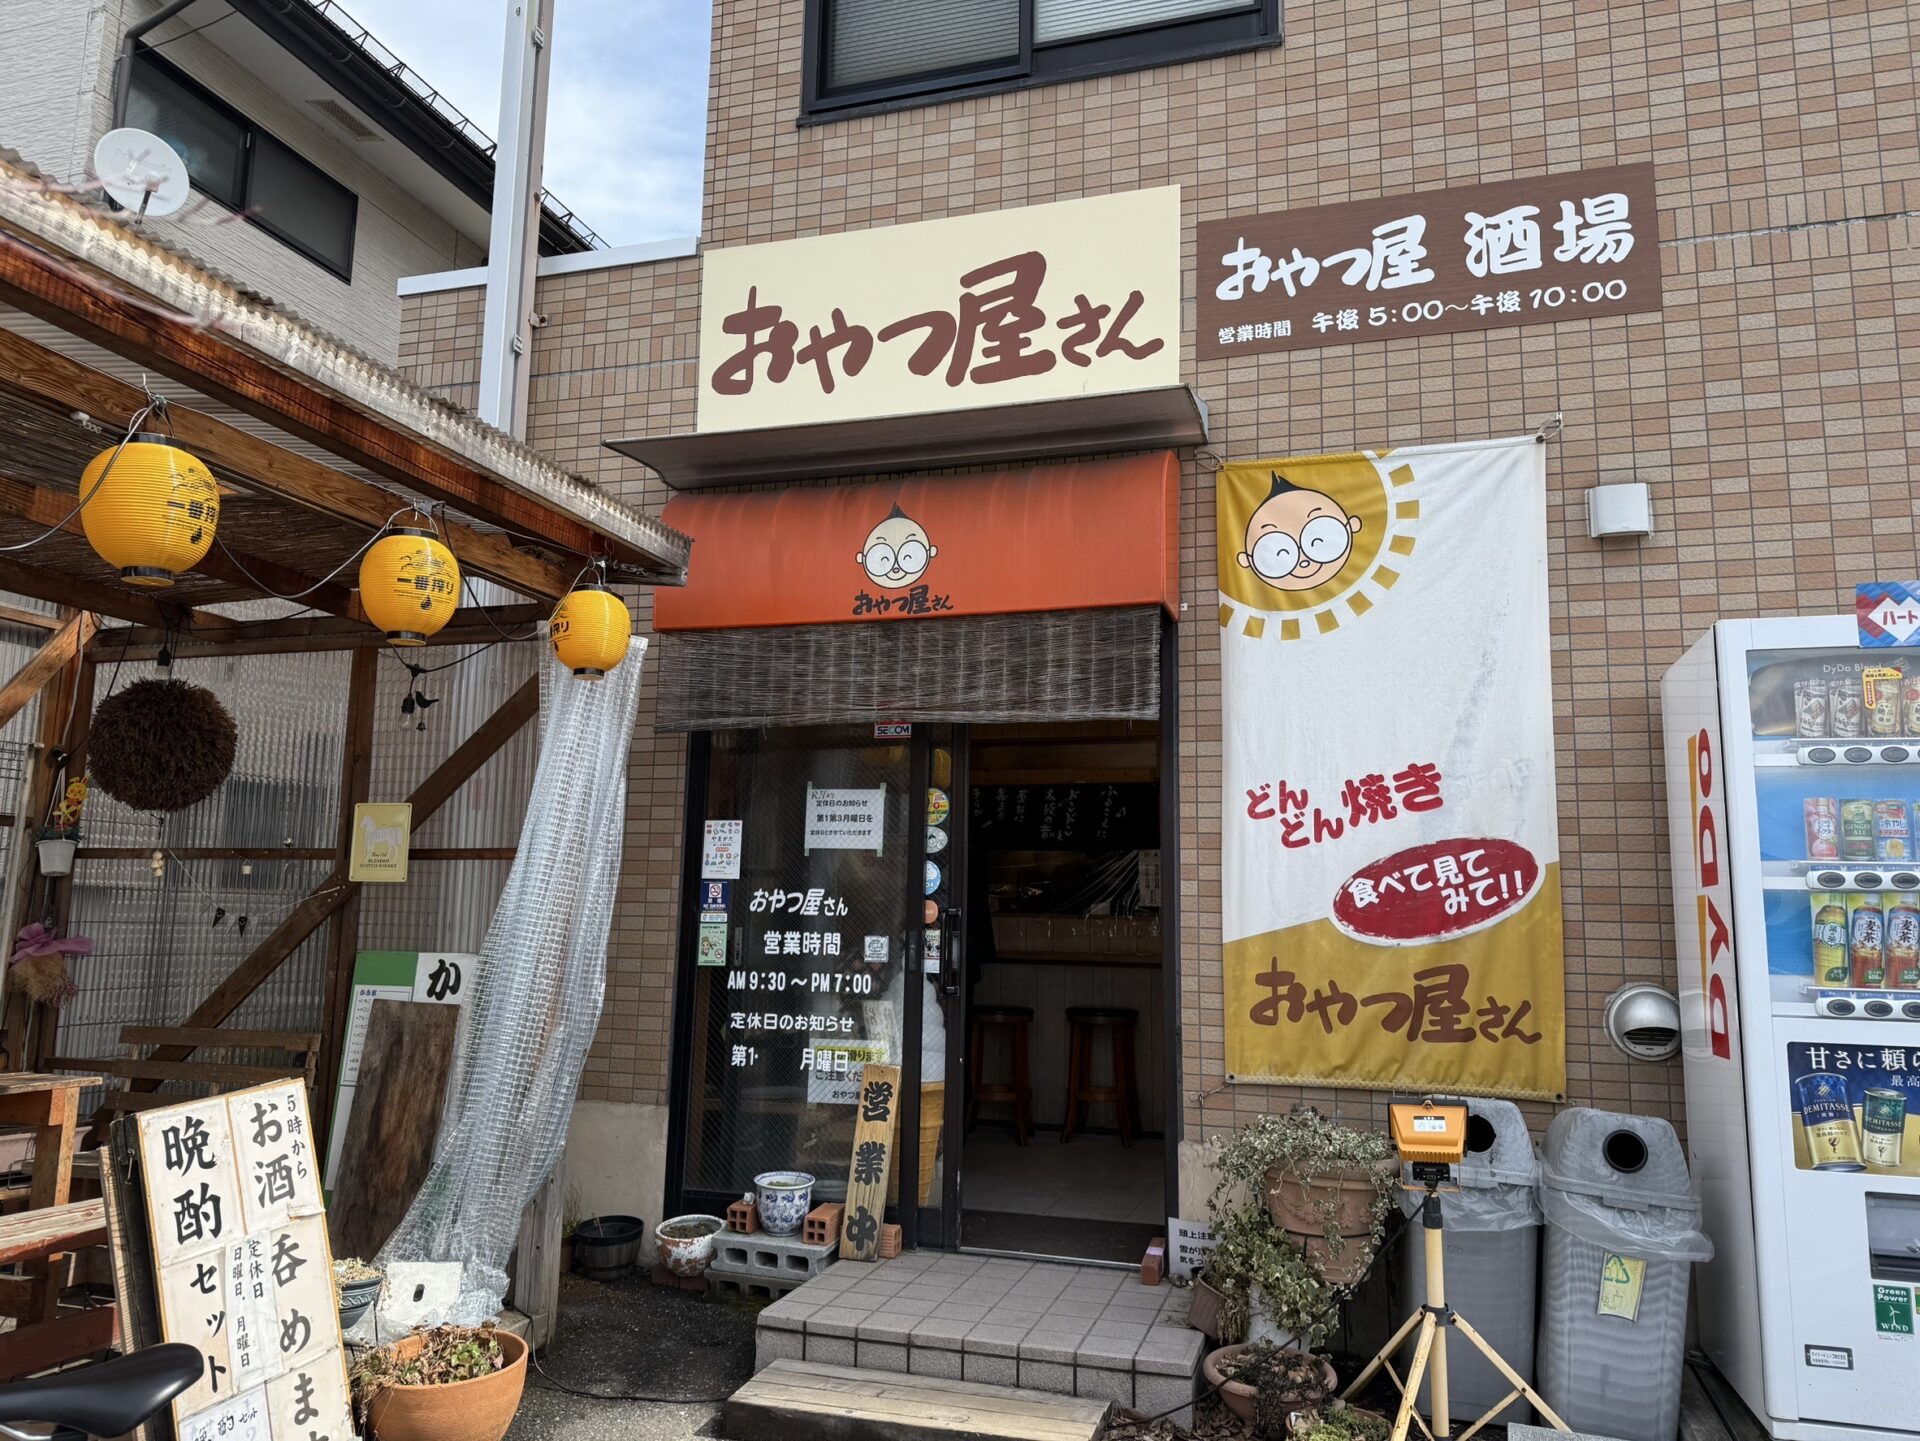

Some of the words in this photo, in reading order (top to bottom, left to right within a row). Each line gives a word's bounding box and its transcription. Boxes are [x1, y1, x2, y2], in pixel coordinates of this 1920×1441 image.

[1215, 214, 1435, 302] おやつ屋
[1464, 192, 1635, 278] 酒場
[711, 250, 1164, 396] おやつ屋さん
[1218, 320, 1292, 345] 営業時間
[1311, 309, 1359, 334] 午後
[1530, 279, 1627, 310] 10:00
[852, 584, 953, 615] おやつ屋さん
[877, 726, 910, 735] SECOM
[816, 799, 868, 807] 定休日のお知らせ
[816, 814, 873, 823] 第1第3月曜日を
[1348, 849, 1490, 909] 食べて見て
[750, 888, 849, 917] おやつ屋さん
[763, 930, 842, 956] 営業時間
[1250, 956, 1543, 1044] おやつ屋さん
[730, 1012, 855, 1033] 定休日のお知らせ
[800, 1047, 849, 1072] 月曜日
[1803, 1102, 1851, 1115] DEMITASSE
[846, 1081, 893, 1251] 営業中
[248, 1239, 265, 1300] 定休日
[1878, 1287, 1907, 1295] Green
[1878, 1293, 1908, 1303] Power
[1881, 1322, 1909, 1331] WIND
